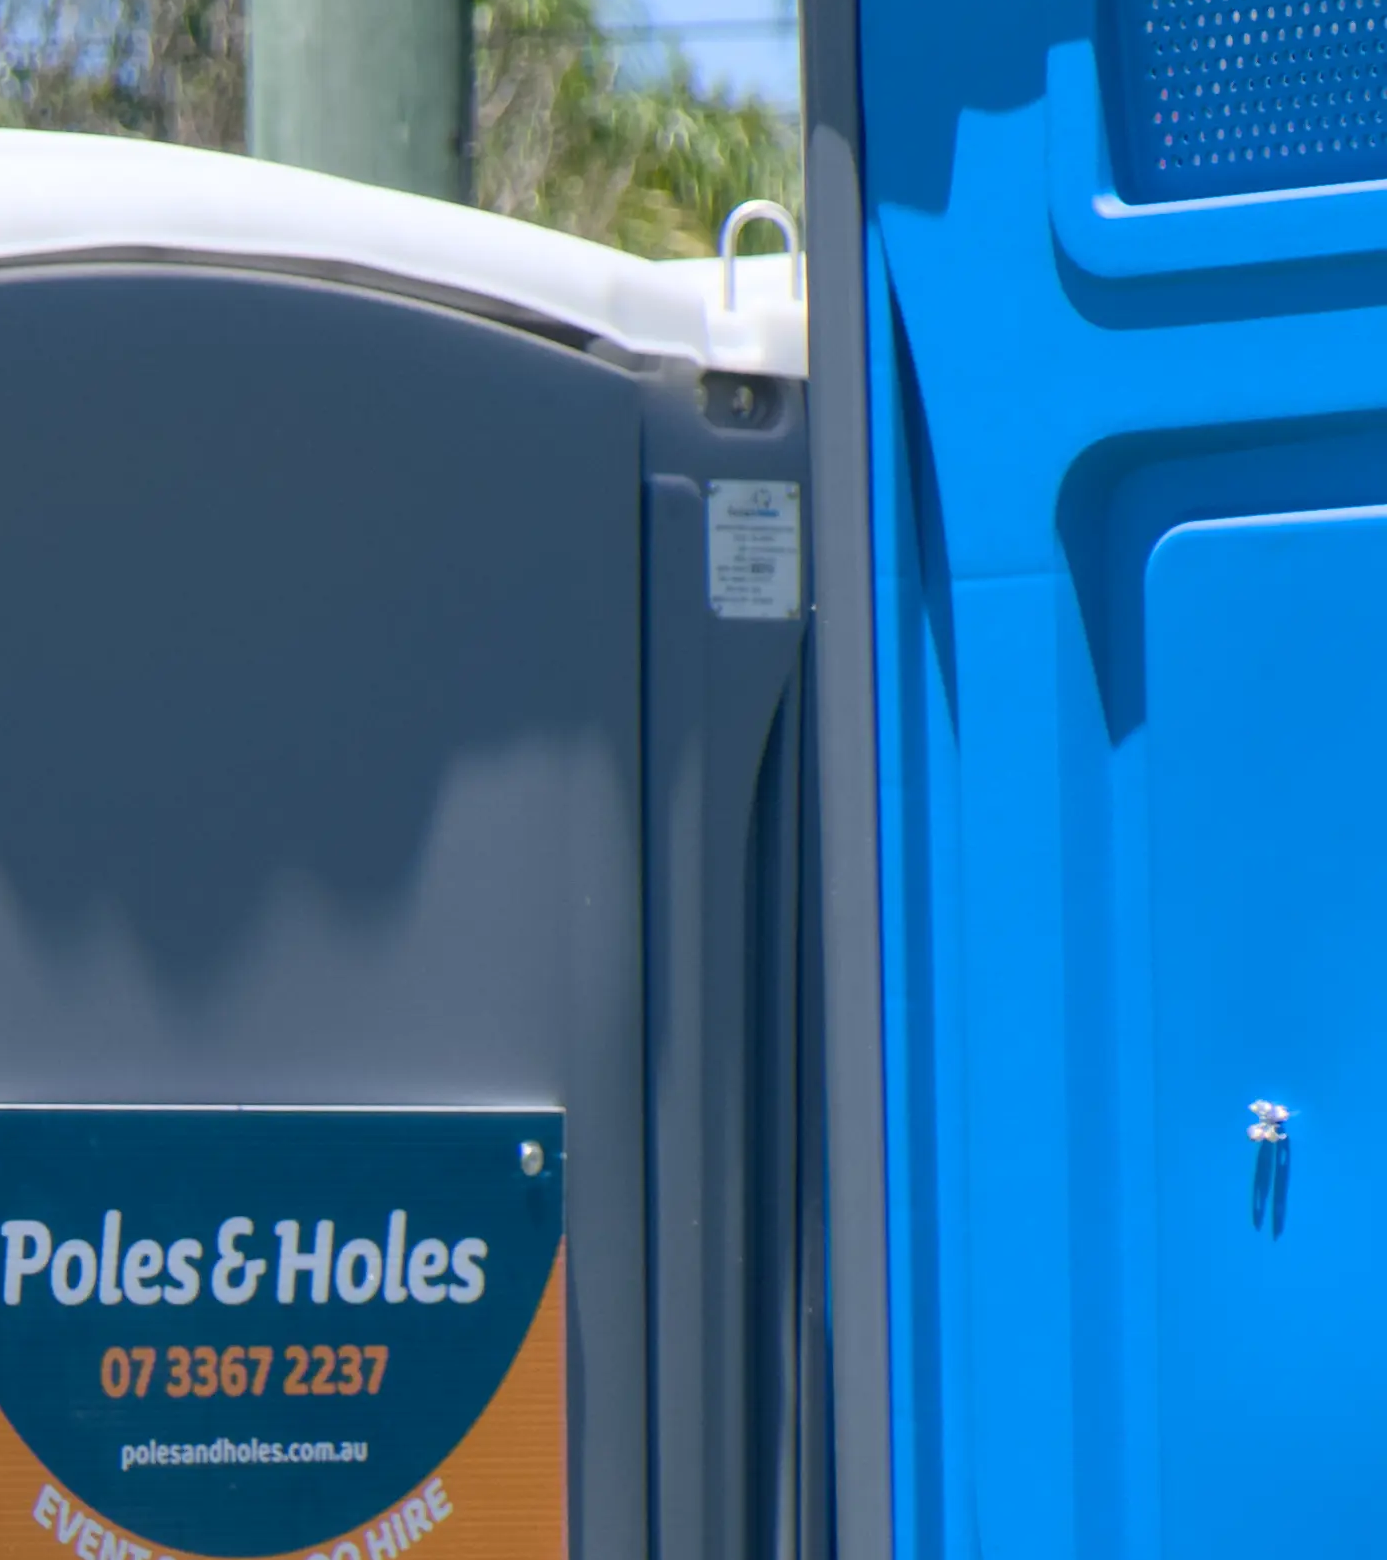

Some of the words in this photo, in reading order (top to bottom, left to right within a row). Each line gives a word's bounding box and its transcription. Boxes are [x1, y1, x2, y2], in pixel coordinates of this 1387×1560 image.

[100, 1346, 157, 1398] 07
[166, 1345, 273, 1398] 3367
[283, 1344, 389, 1396] 2237
[121, 1438, 368, 1470] polesandholes.com.au
